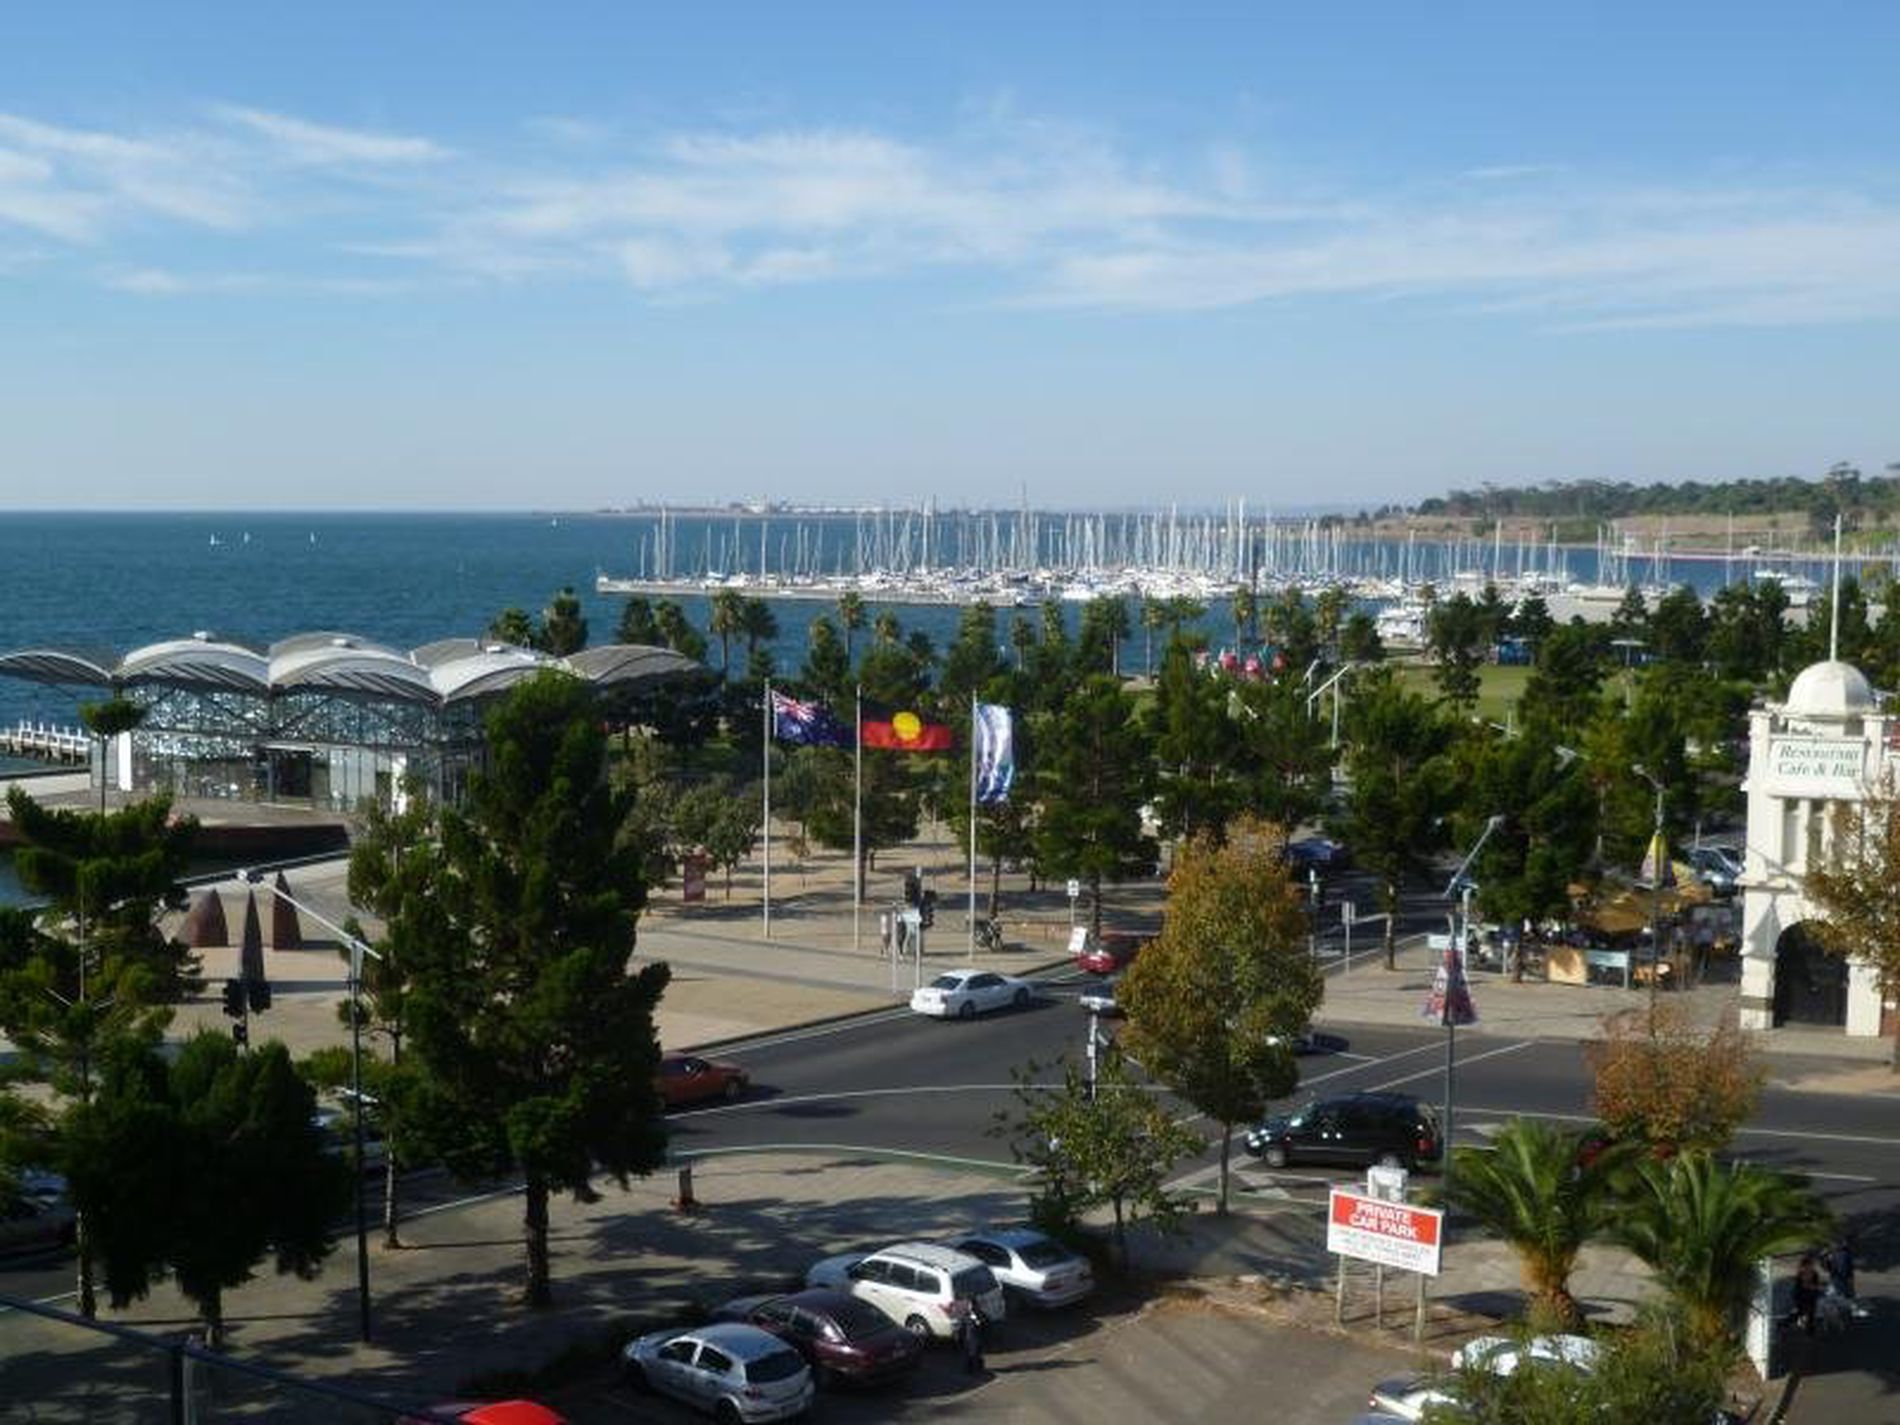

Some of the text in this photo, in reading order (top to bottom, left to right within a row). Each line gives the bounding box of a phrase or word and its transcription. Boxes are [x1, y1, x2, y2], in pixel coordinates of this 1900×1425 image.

[1779, 745, 1861, 760] Restaurant
[1813, 762, 1826, 776] &
[1832, 763, 1861, 777] Bar
[1355, 1202, 1412, 1225] PRIVATE
[1348, 1213, 1419, 1238] CAR PARK
